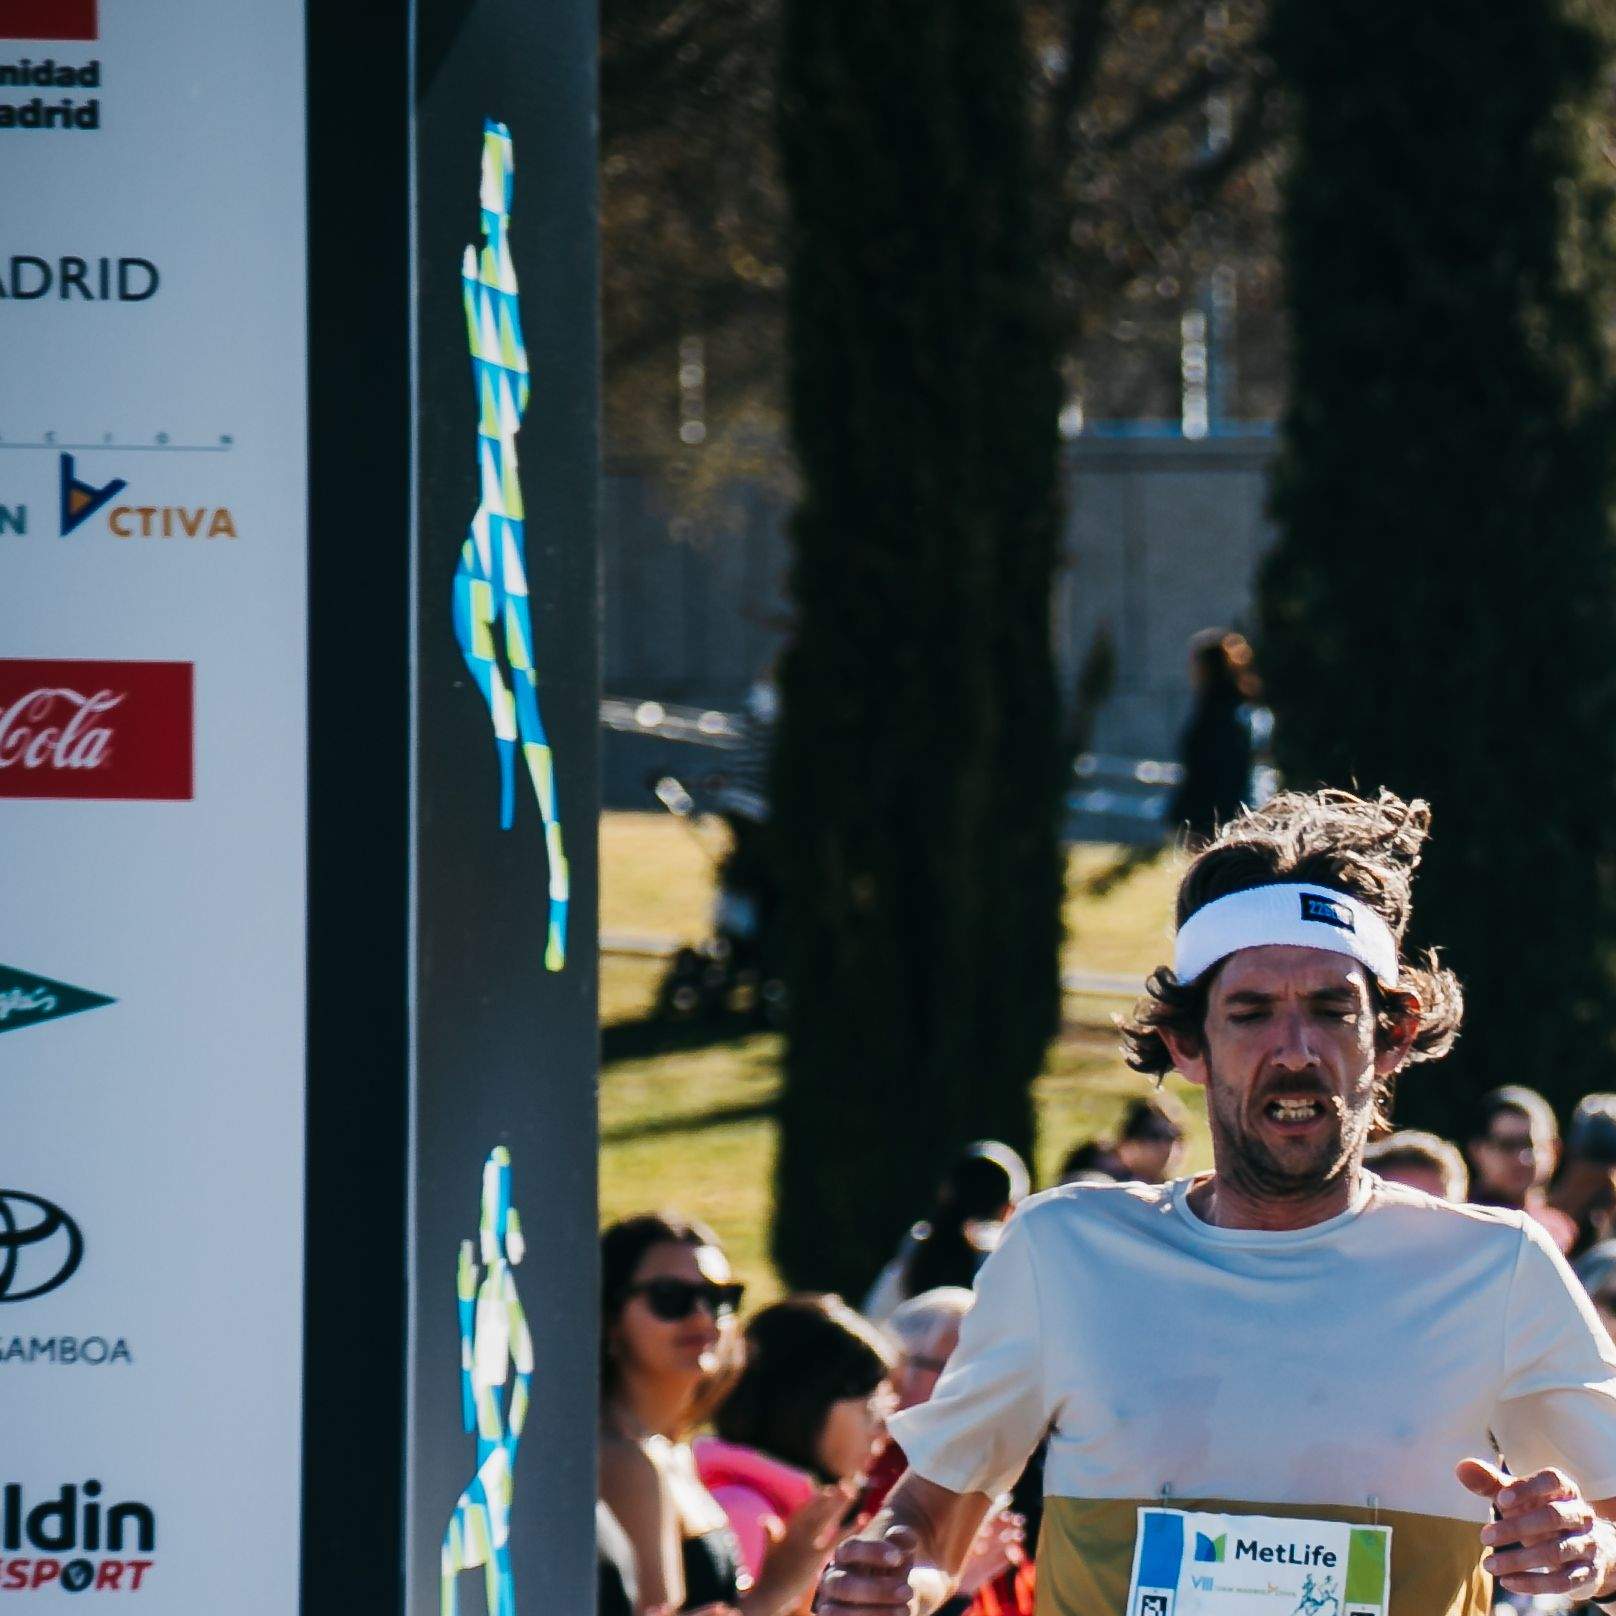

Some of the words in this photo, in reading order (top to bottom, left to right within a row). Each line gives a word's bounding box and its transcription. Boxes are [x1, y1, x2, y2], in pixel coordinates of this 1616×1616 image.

[0, 254, 160, 301] DRID
[0, 1335, 133, 1365] AMBOA
[4, 1479, 156, 1552] ldin
[1235, 1538, 1337, 1568] MetLife
[0, 1558, 154, 1592] SPORT
